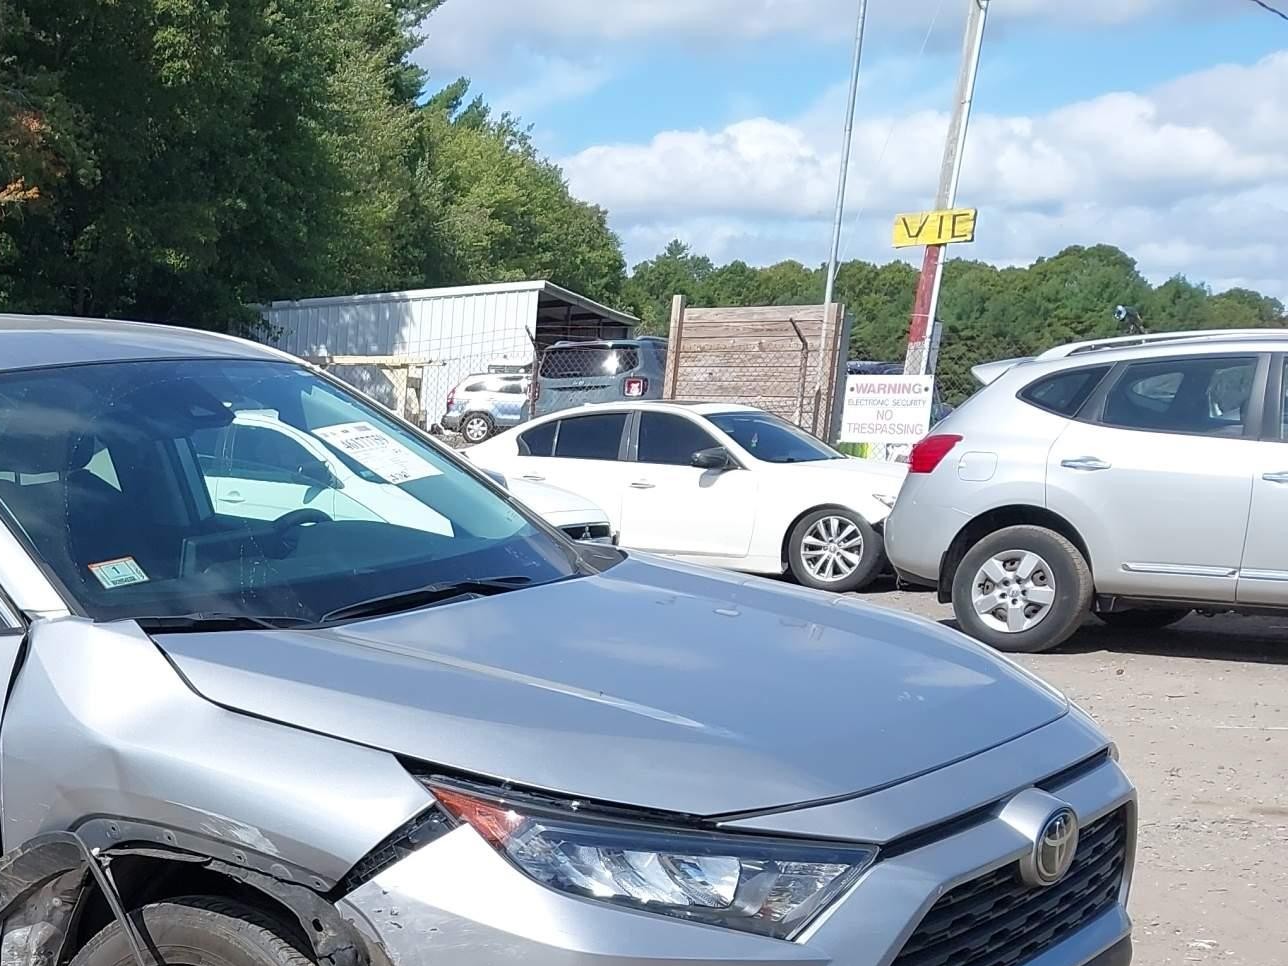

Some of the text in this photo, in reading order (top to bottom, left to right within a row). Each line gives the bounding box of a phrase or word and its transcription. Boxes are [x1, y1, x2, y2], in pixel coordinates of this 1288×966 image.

[855, 383, 923, 394] WARNING
[848, 398, 927, 407] ELECTRONIC SECURITY
[876, 409, 894, 421] NO
[847, 422, 924, 435] TRESPASSING
